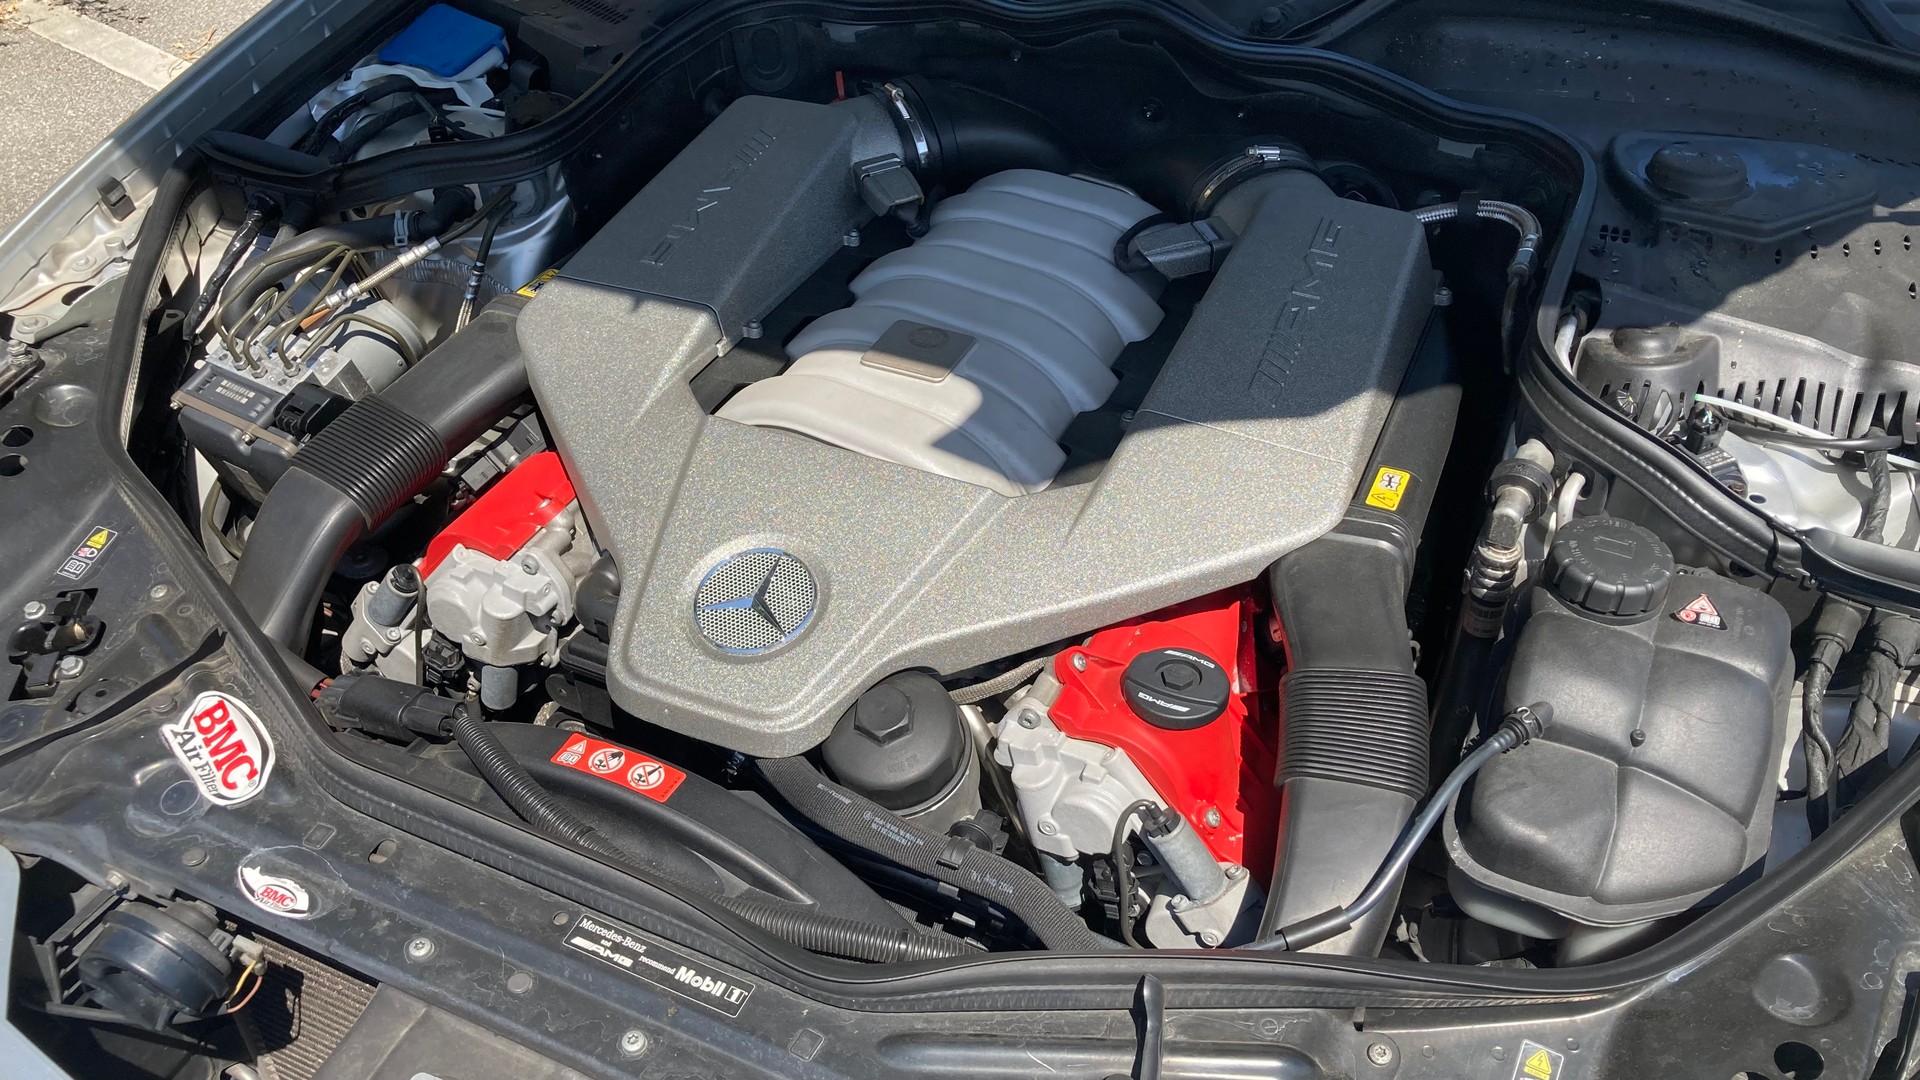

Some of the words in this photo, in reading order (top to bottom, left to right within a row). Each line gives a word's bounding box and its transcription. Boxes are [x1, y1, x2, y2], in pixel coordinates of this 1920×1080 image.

[170, 729, 203, 762] Air
[193, 761, 219, 794] Filter
[193, 699, 259, 790] BMC
[259, 886, 295, 907] BMC
[579, 918, 647, 953] Mercedes-Benz
[600, 939, 613, 948] and
[638, 955, 677, 975] recommend
[674, 965, 727, 997] Mobil
